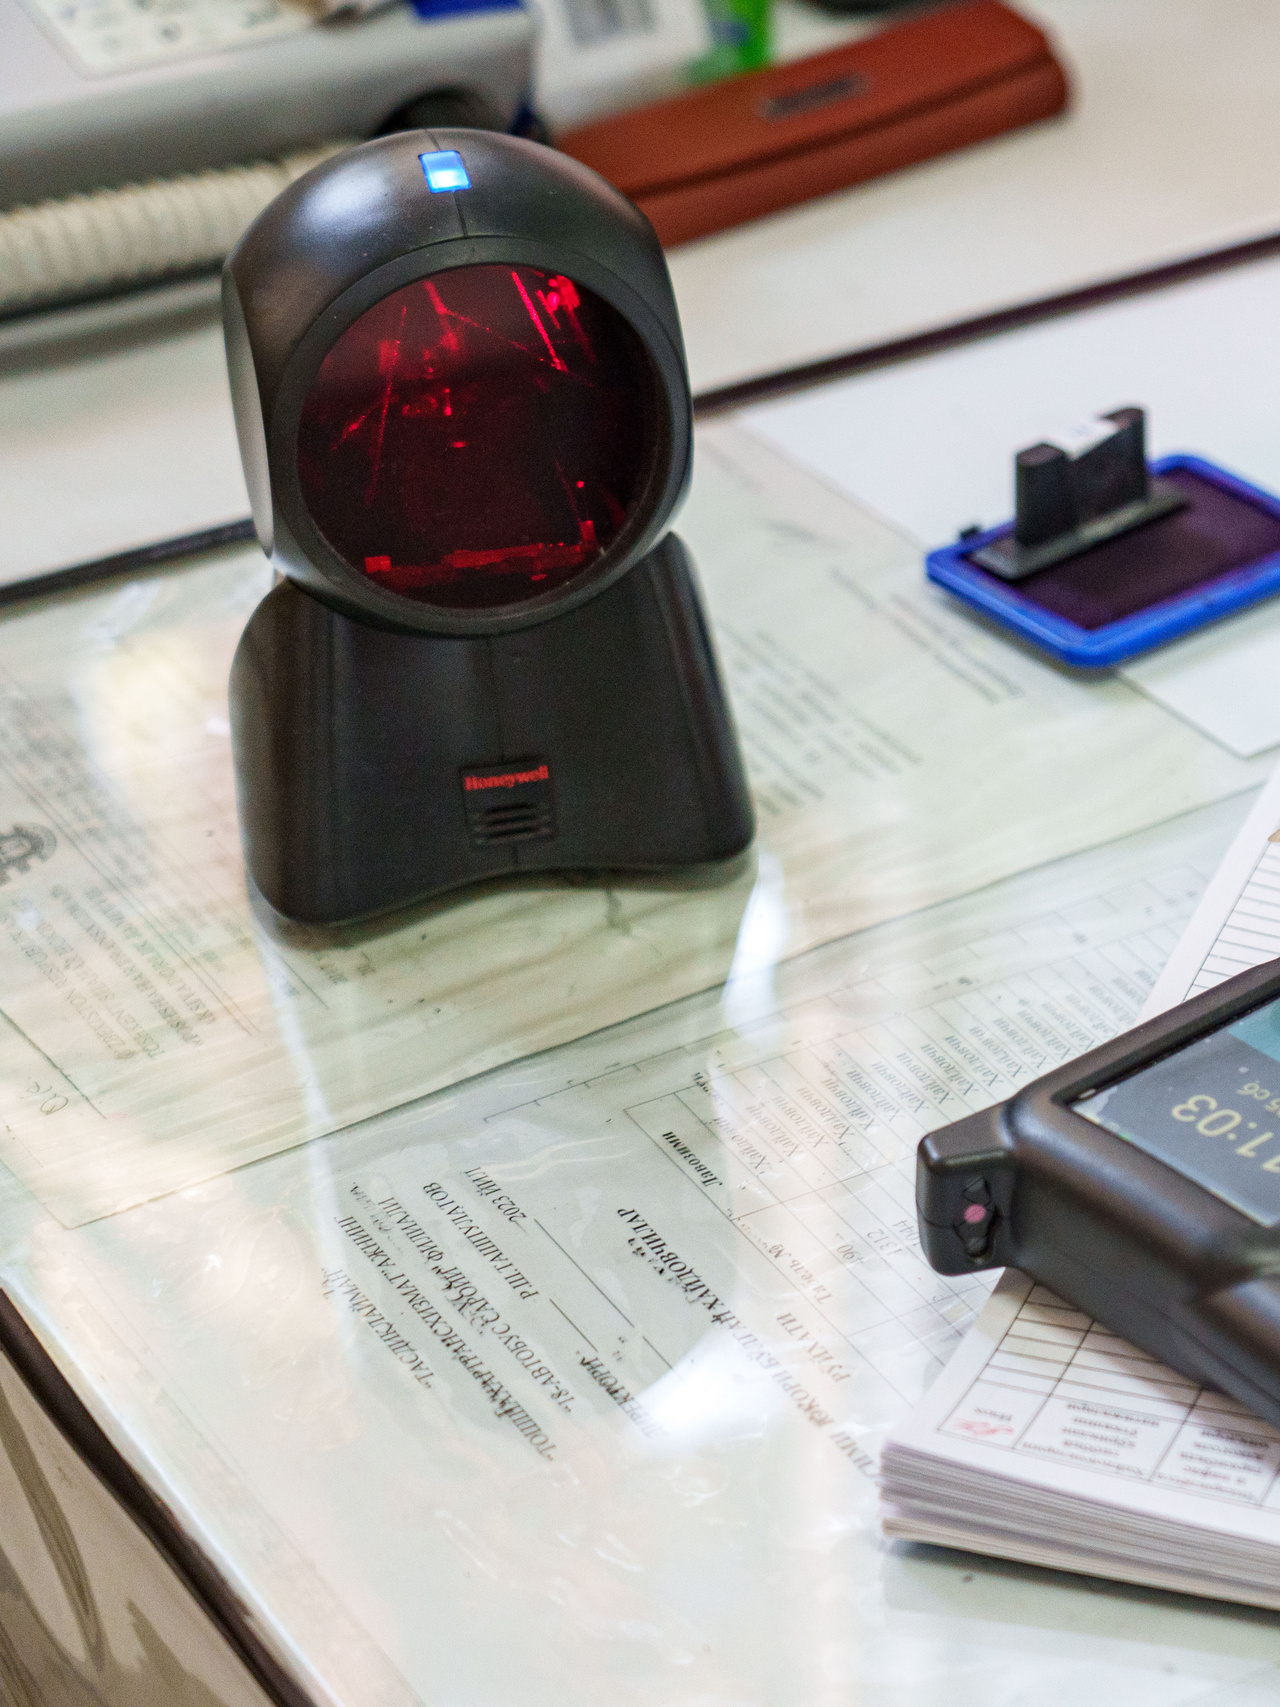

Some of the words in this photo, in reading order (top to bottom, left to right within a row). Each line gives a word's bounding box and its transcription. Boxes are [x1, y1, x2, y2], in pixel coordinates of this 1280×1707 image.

[464, 765, 548, 791] Honeywell
[660, 1131, 723, 1189] Лавозими
[463, 1164, 501, 1198] ЙИЛ
[491, 1193, 528, 1223] 2023
[377, 1197, 446, 1264] ФИЛИАЛИ
